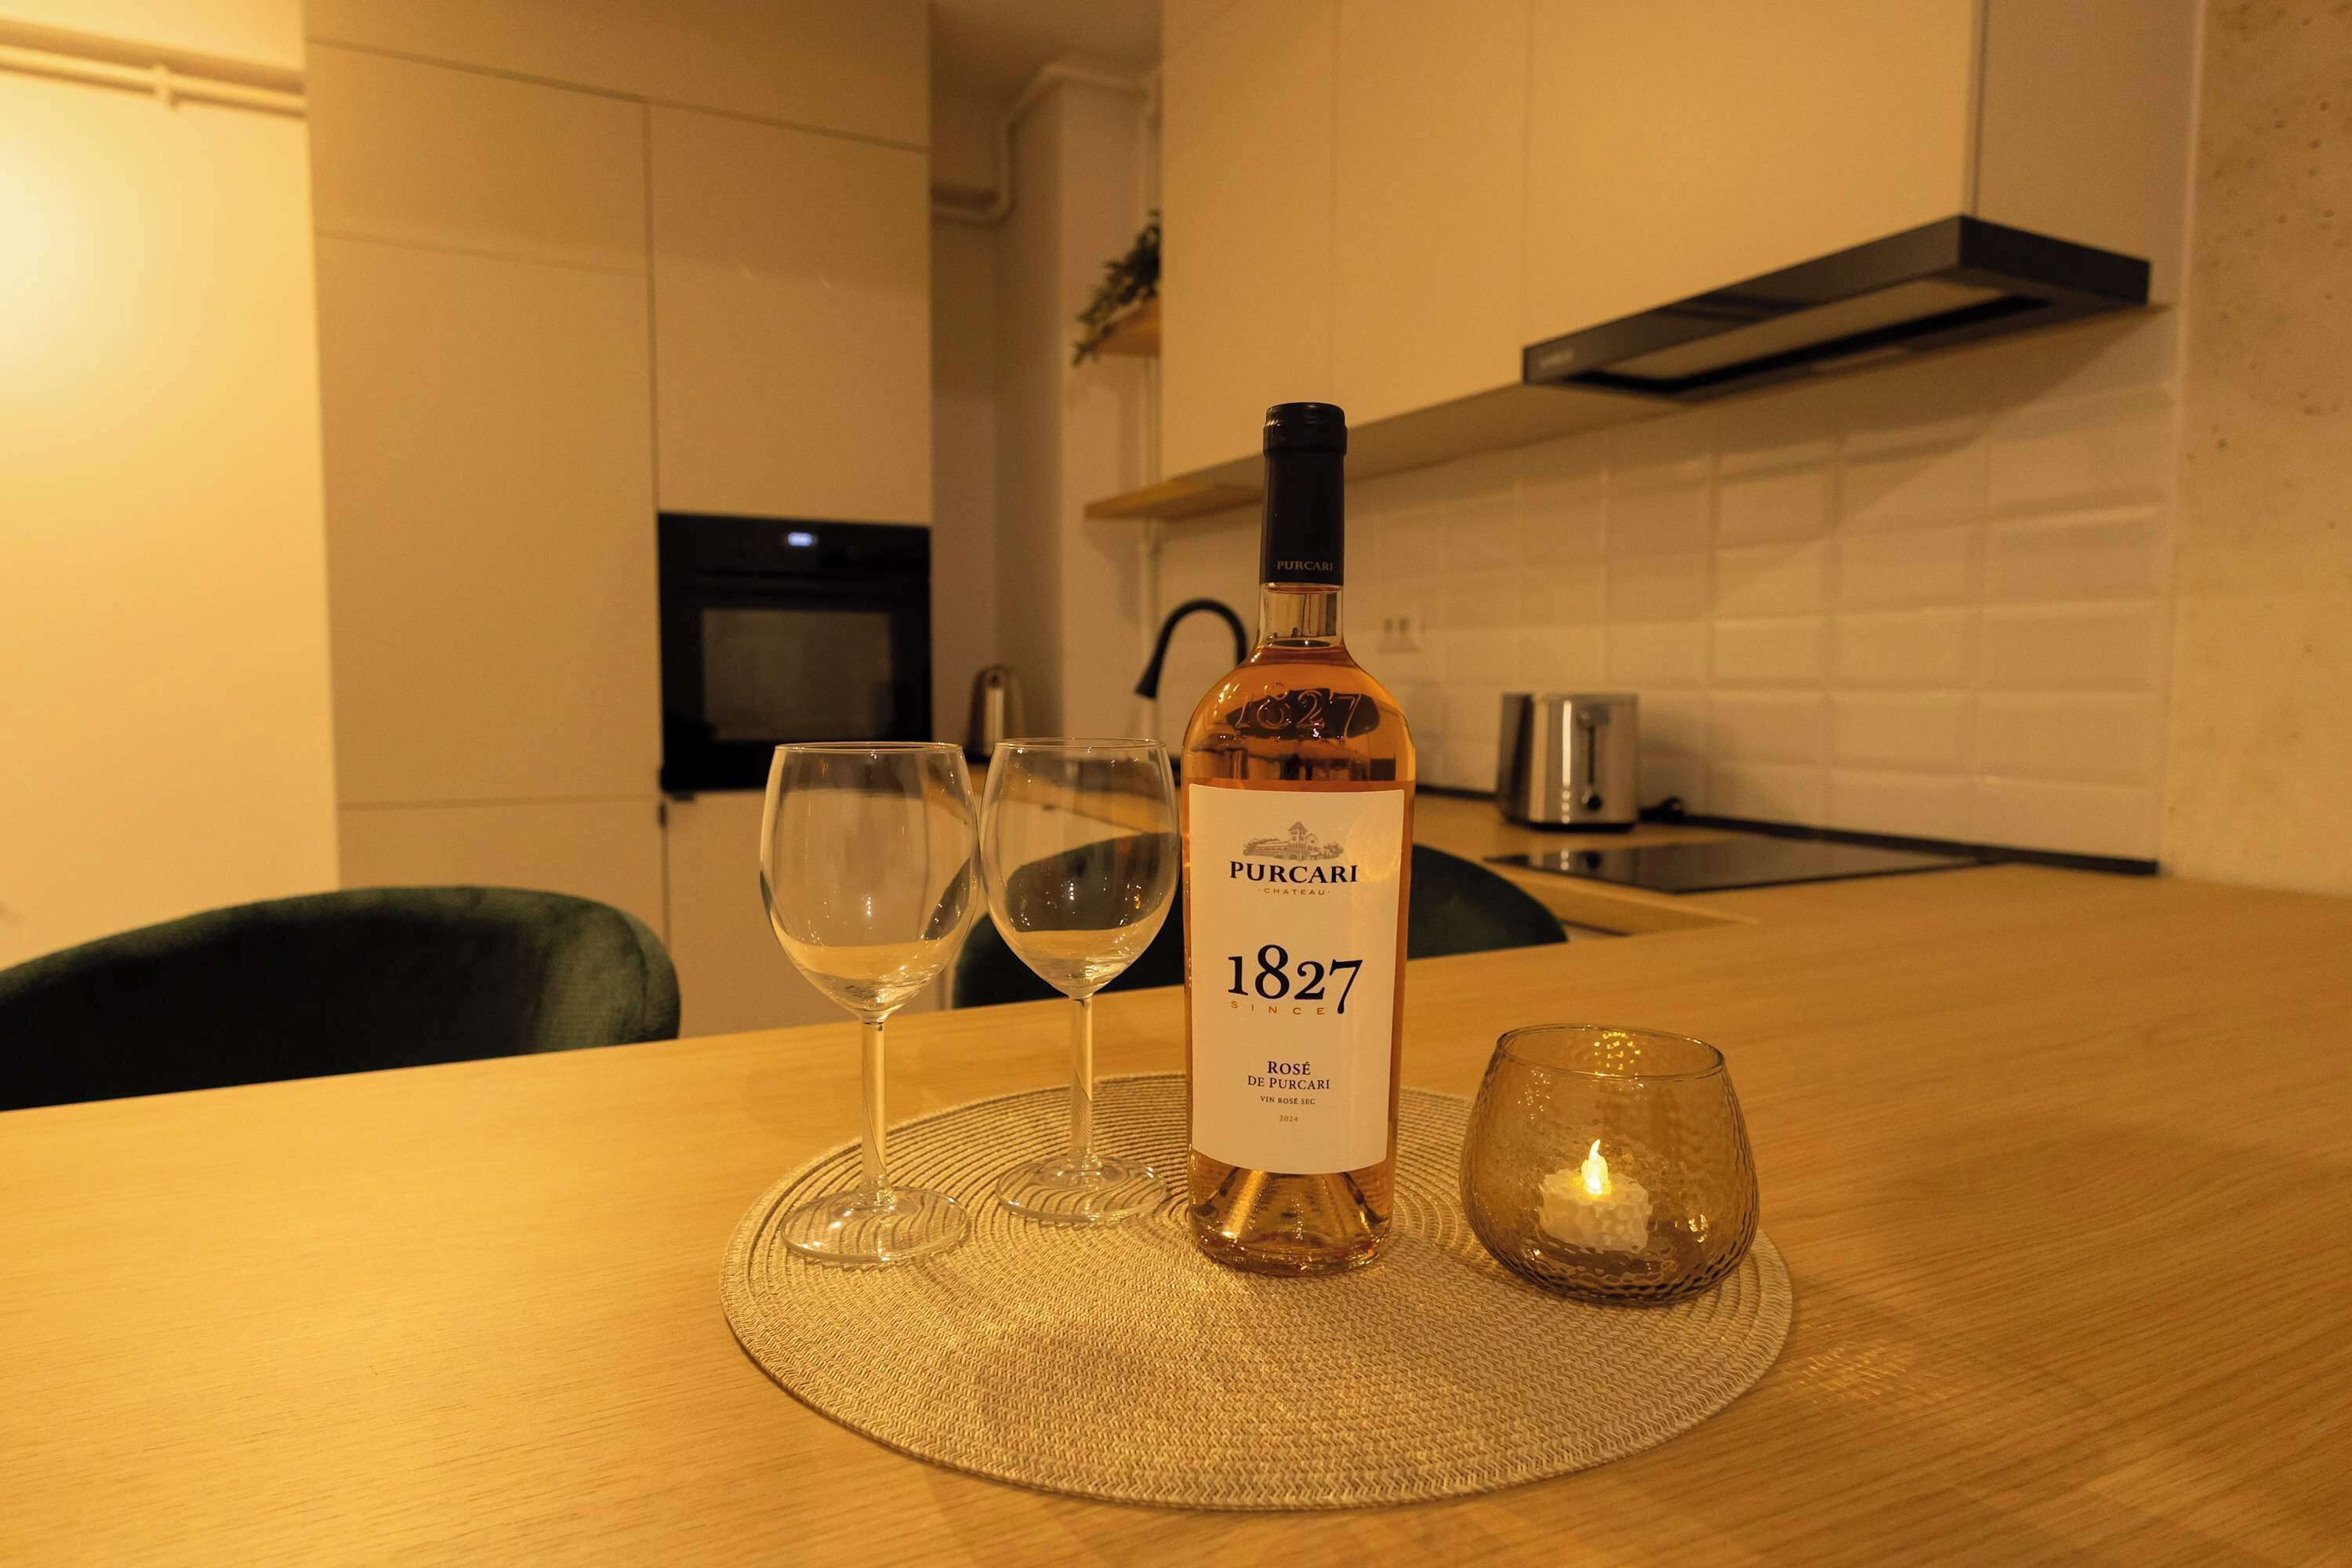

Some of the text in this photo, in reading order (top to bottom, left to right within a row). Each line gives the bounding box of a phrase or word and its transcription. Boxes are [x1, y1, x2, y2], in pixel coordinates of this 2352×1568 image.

[1276, 560, 1334, 572] PURCARI
[1235, 682, 1363, 739] 1827
[1229, 860, 1358, 884] PURCARI
[1263, 887, 1326, 895] CHATEAU
[1228, 944, 1363, 1014] 1827
[1231, 1000, 1325, 1015] SINCE
[1267, 1061, 1311, 1076] ROSÉ
[1247, 1075, 1330, 1090] DE PURCARI
